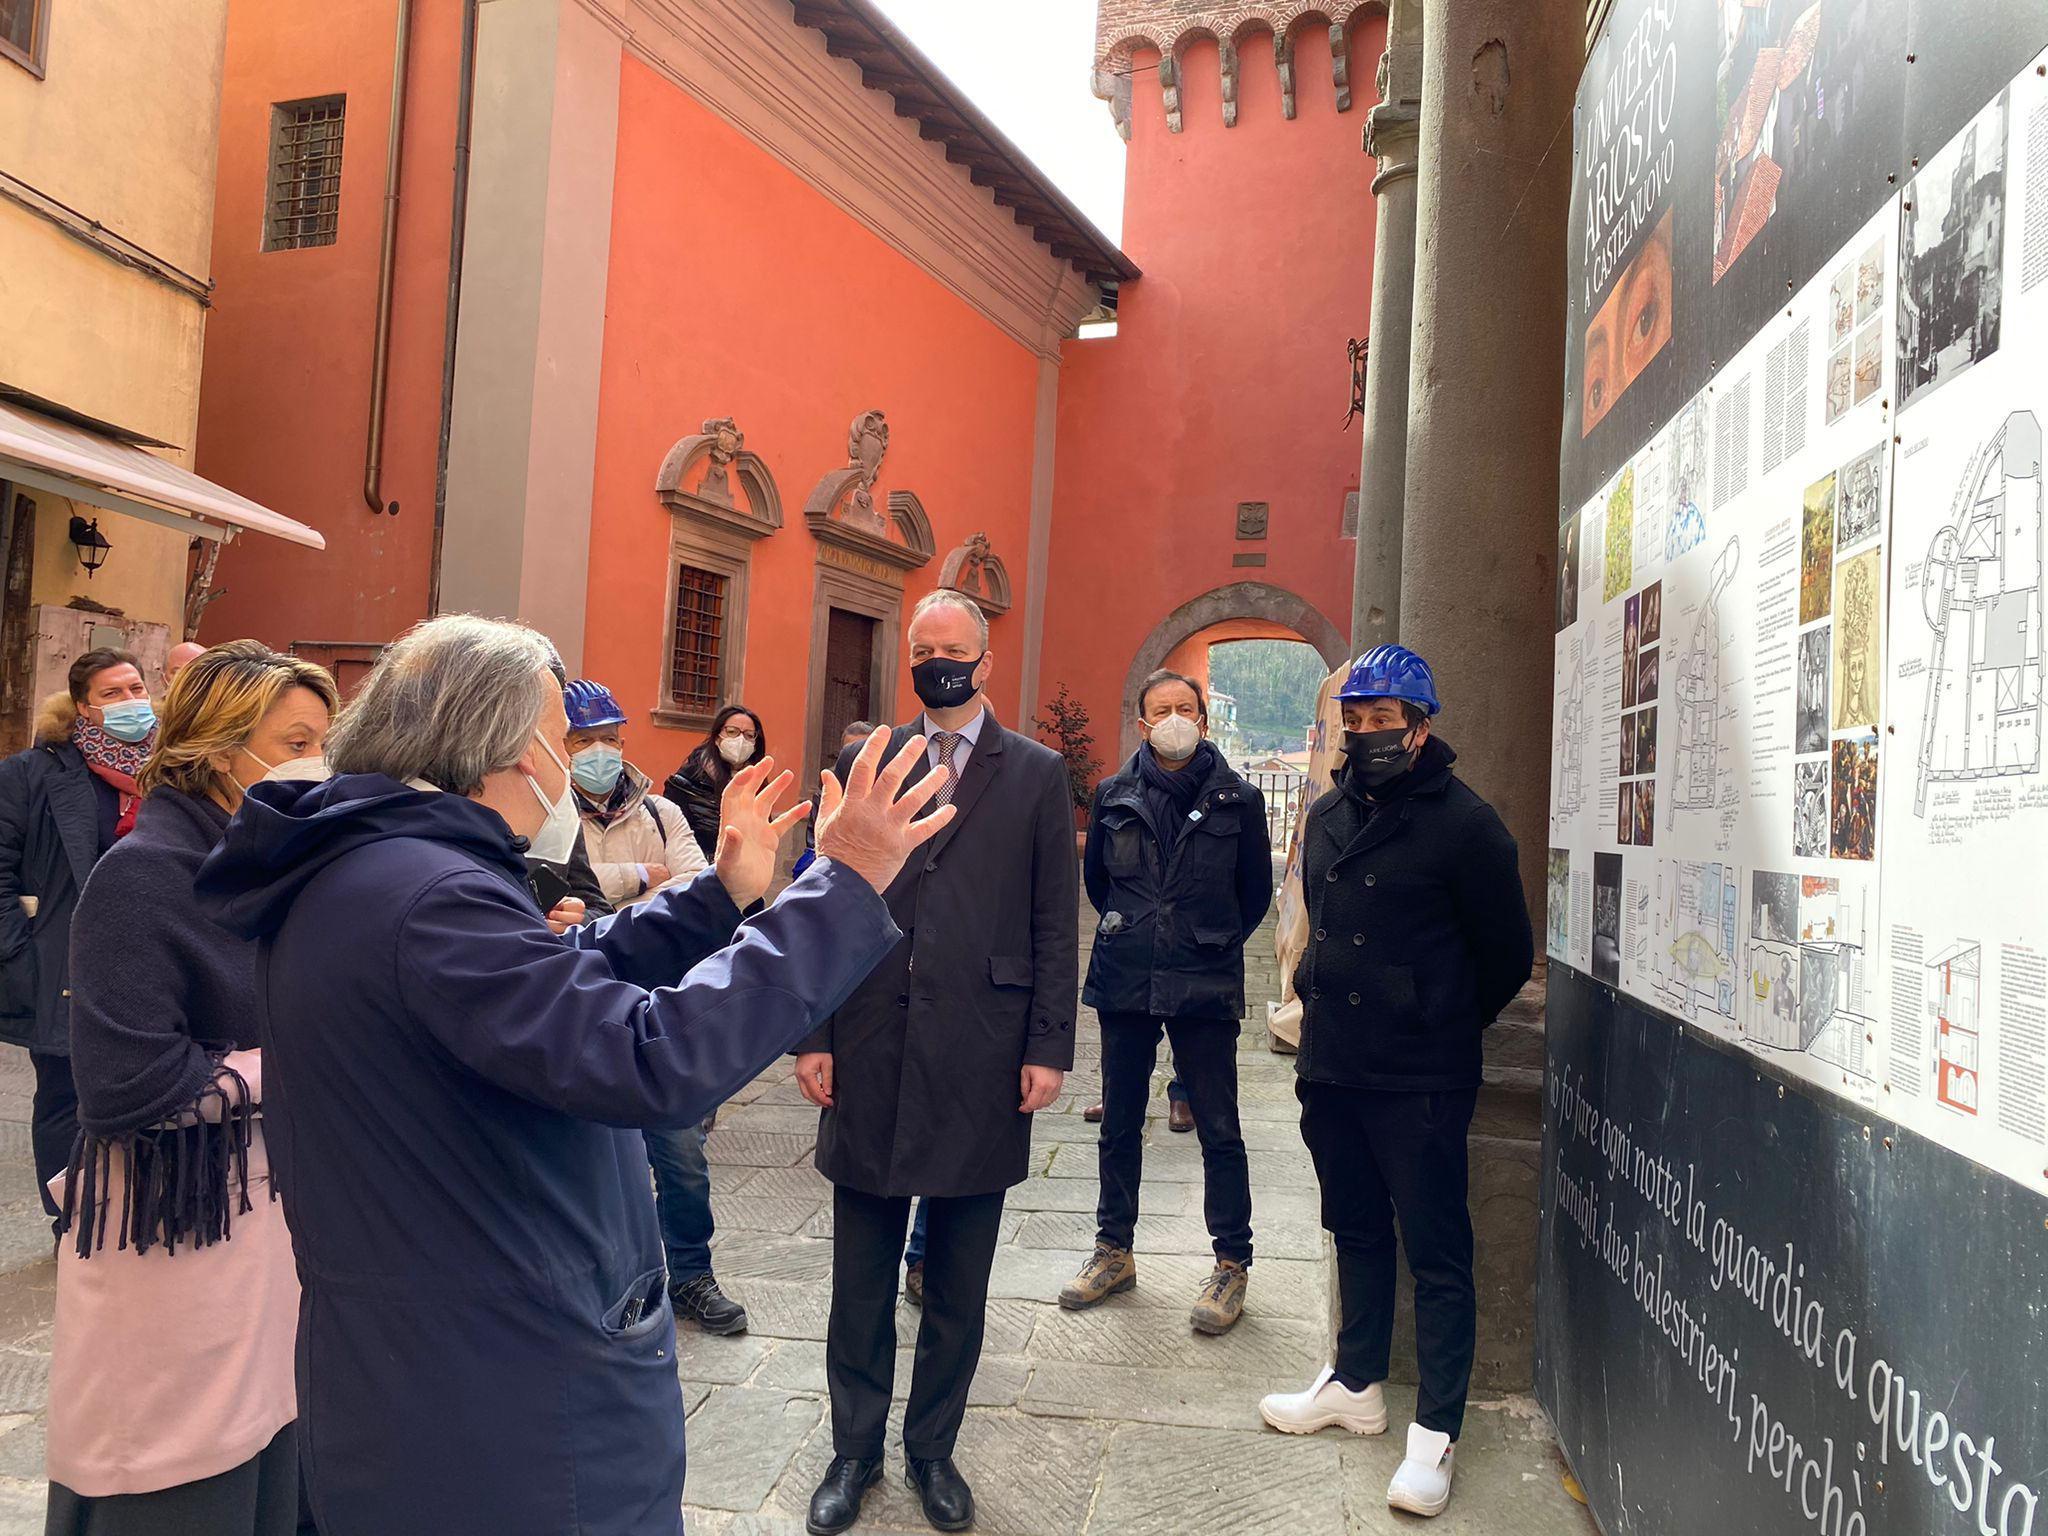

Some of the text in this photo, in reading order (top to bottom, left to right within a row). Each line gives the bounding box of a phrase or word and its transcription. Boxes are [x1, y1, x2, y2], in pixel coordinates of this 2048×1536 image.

[1584, 41, 1677, 266] ARIOSTO
[1584, 138, 1675, 314] A CASTELNUOVO
[1553, 1148, 1600, 1259] famigli,
[1603, 1201, 1629, 1285] due
[1633, 1230, 1741, 1442] balestrieri,
[1558, 1063, 1574, 1129] fo
[1572, 1074, 1599, 1146] fare
[1602, 1117, 1632, 1181] ogni
[1634, 1146, 1683, 1226] notte
[1685, 1163, 1706, 1253] la
[1710, 1217, 1825, 1368] guardia
[1835, 1328, 1858, 1400] a
[1868, 1359, 2039, 1536] questa
